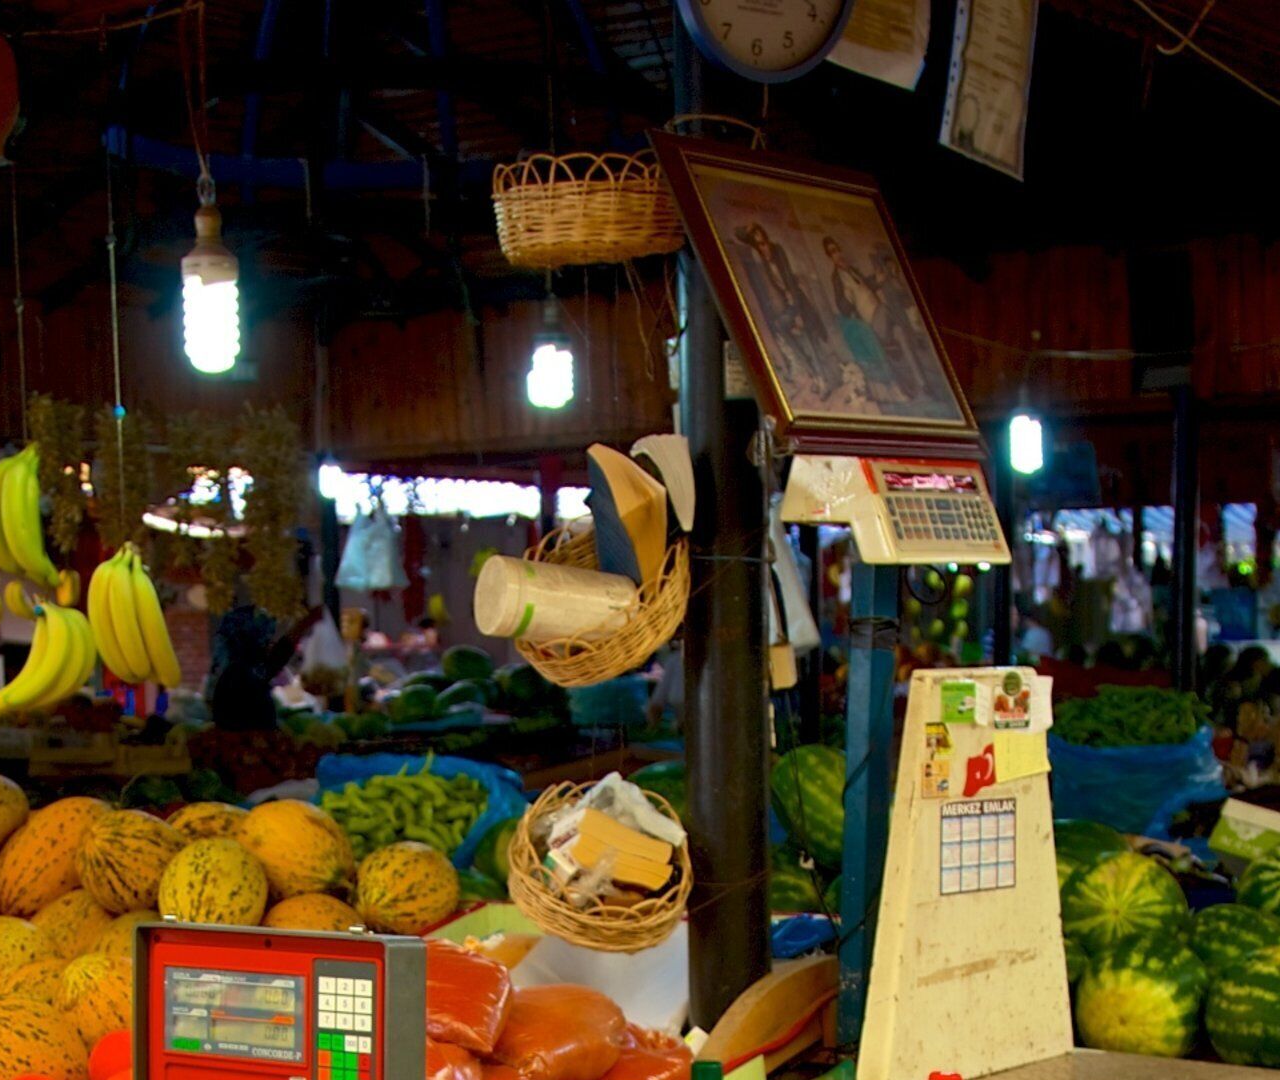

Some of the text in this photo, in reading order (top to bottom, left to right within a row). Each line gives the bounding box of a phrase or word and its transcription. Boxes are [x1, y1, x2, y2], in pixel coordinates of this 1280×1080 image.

[721, 22, 732, 40] 7
[782, 31, 794, 49] 5
[751, 38, 763, 57] 6
[942, 799, 1015, 816] MERKEZ EMLAK
